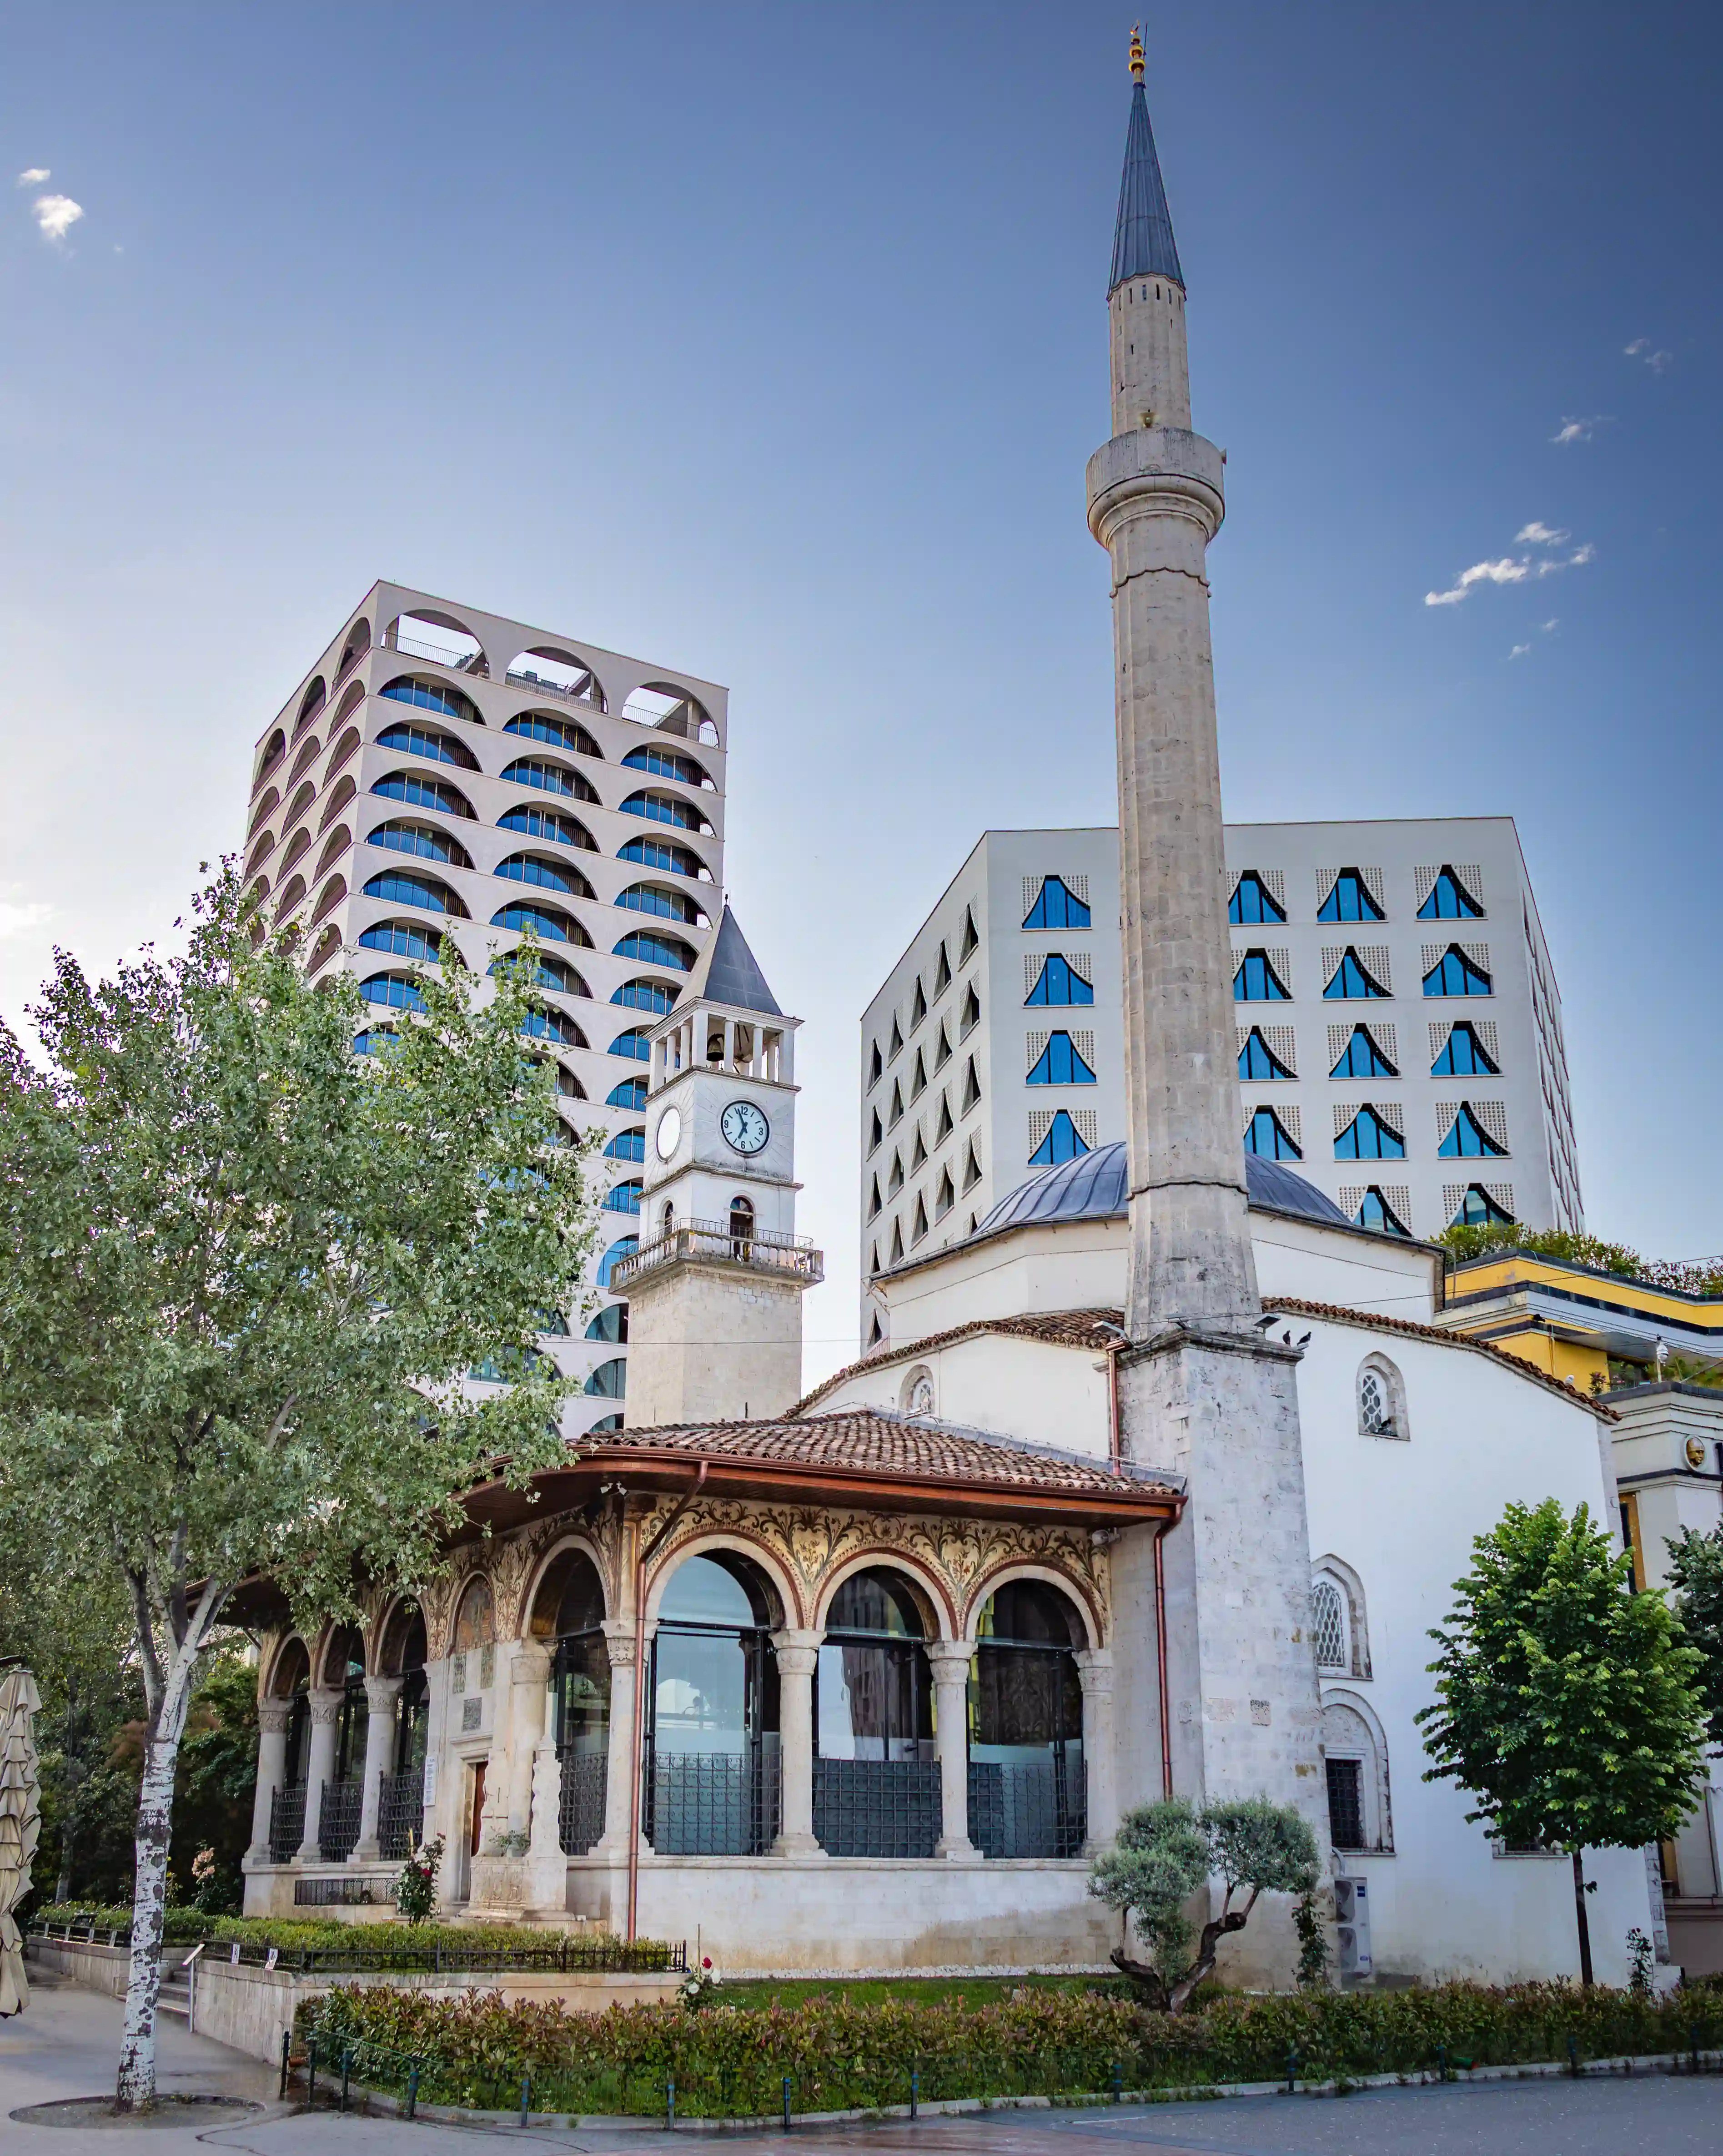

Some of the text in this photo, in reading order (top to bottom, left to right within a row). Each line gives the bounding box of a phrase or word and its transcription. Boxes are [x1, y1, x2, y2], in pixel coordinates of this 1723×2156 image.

[741, 1106, 748, 1115] 12
[723, 1120, 728, 1128] 9
[759, 1127, 763, 1136] 3
[741, 1140, 745, 1149] 6
